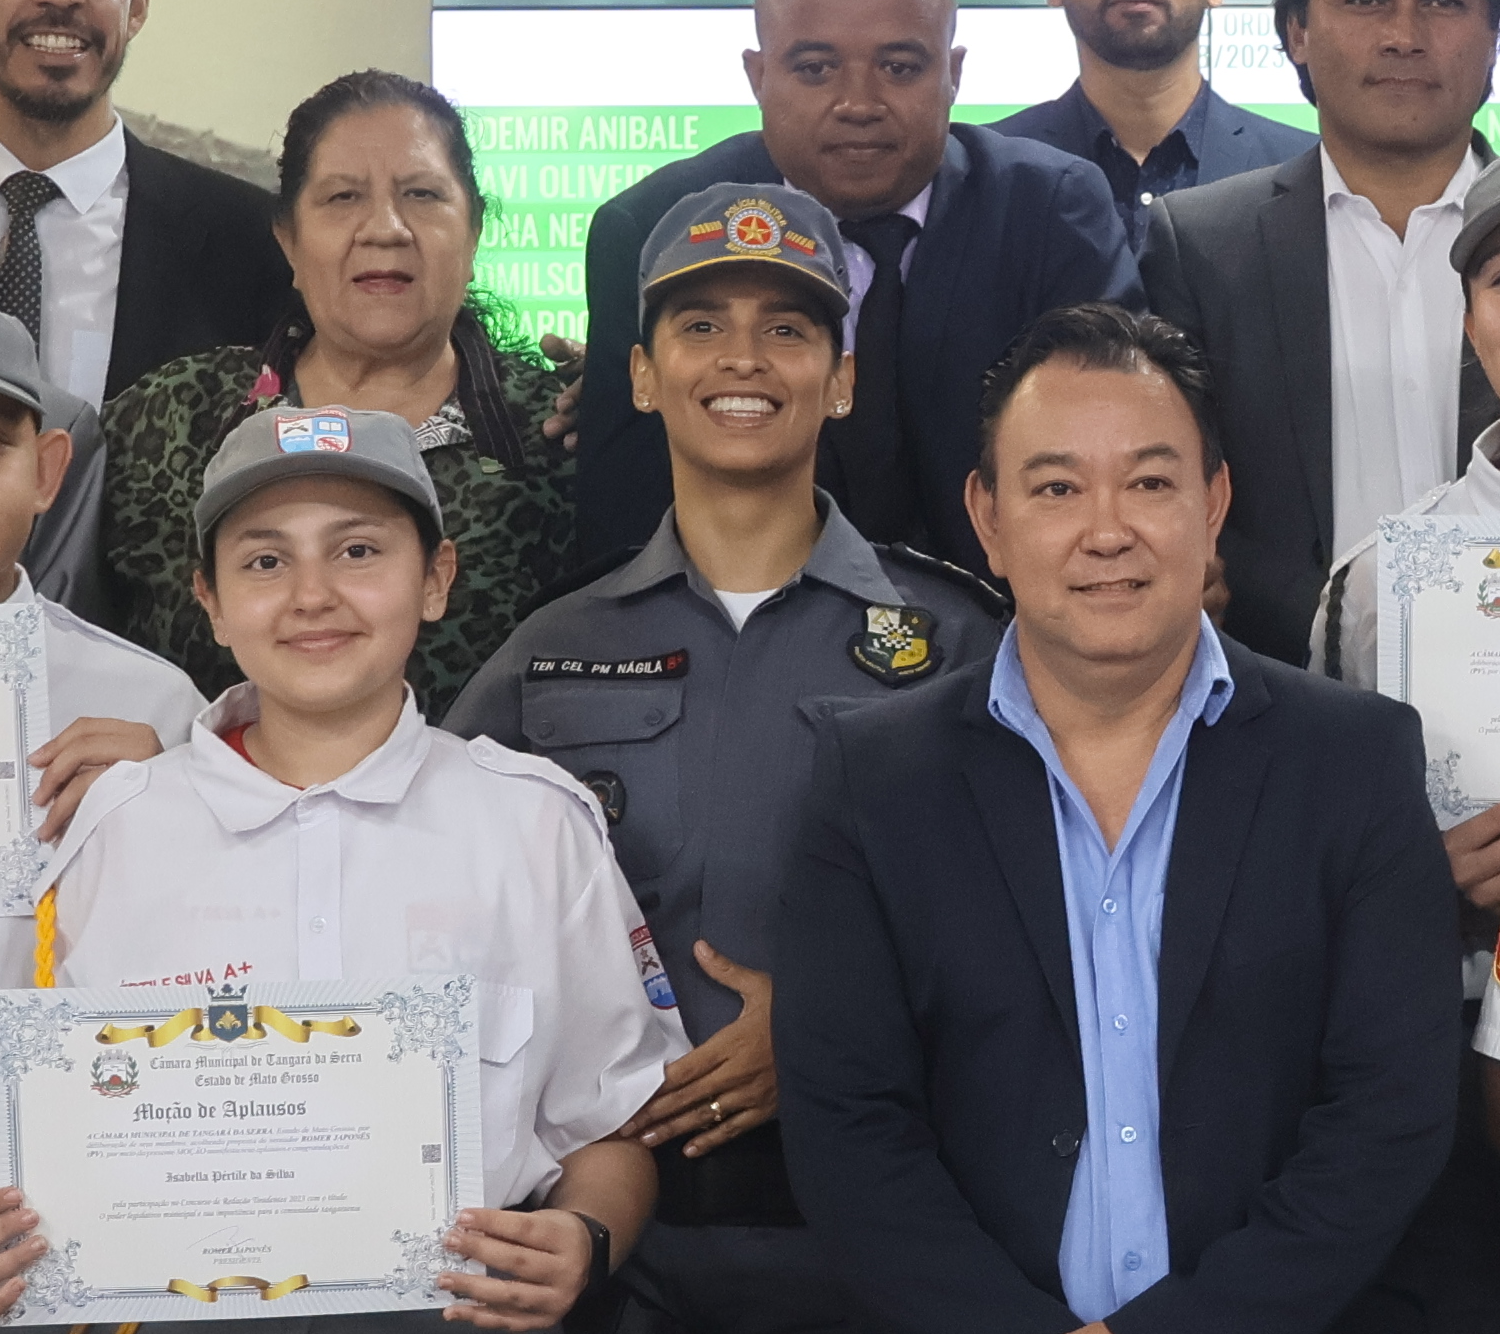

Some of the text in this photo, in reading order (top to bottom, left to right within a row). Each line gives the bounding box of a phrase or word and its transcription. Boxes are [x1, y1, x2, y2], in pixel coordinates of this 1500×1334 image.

[578, 115, 699, 150] ANIBALE
[532, 661, 556, 671] TEN
[561, 660, 584, 672] CEL
[591, 664, 612, 674] PM
[616, 660, 663, 674] NÁGILA
[223, 961, 253, 980] A+
[133, 1101, 306, 1123] Moção de Aplausos
